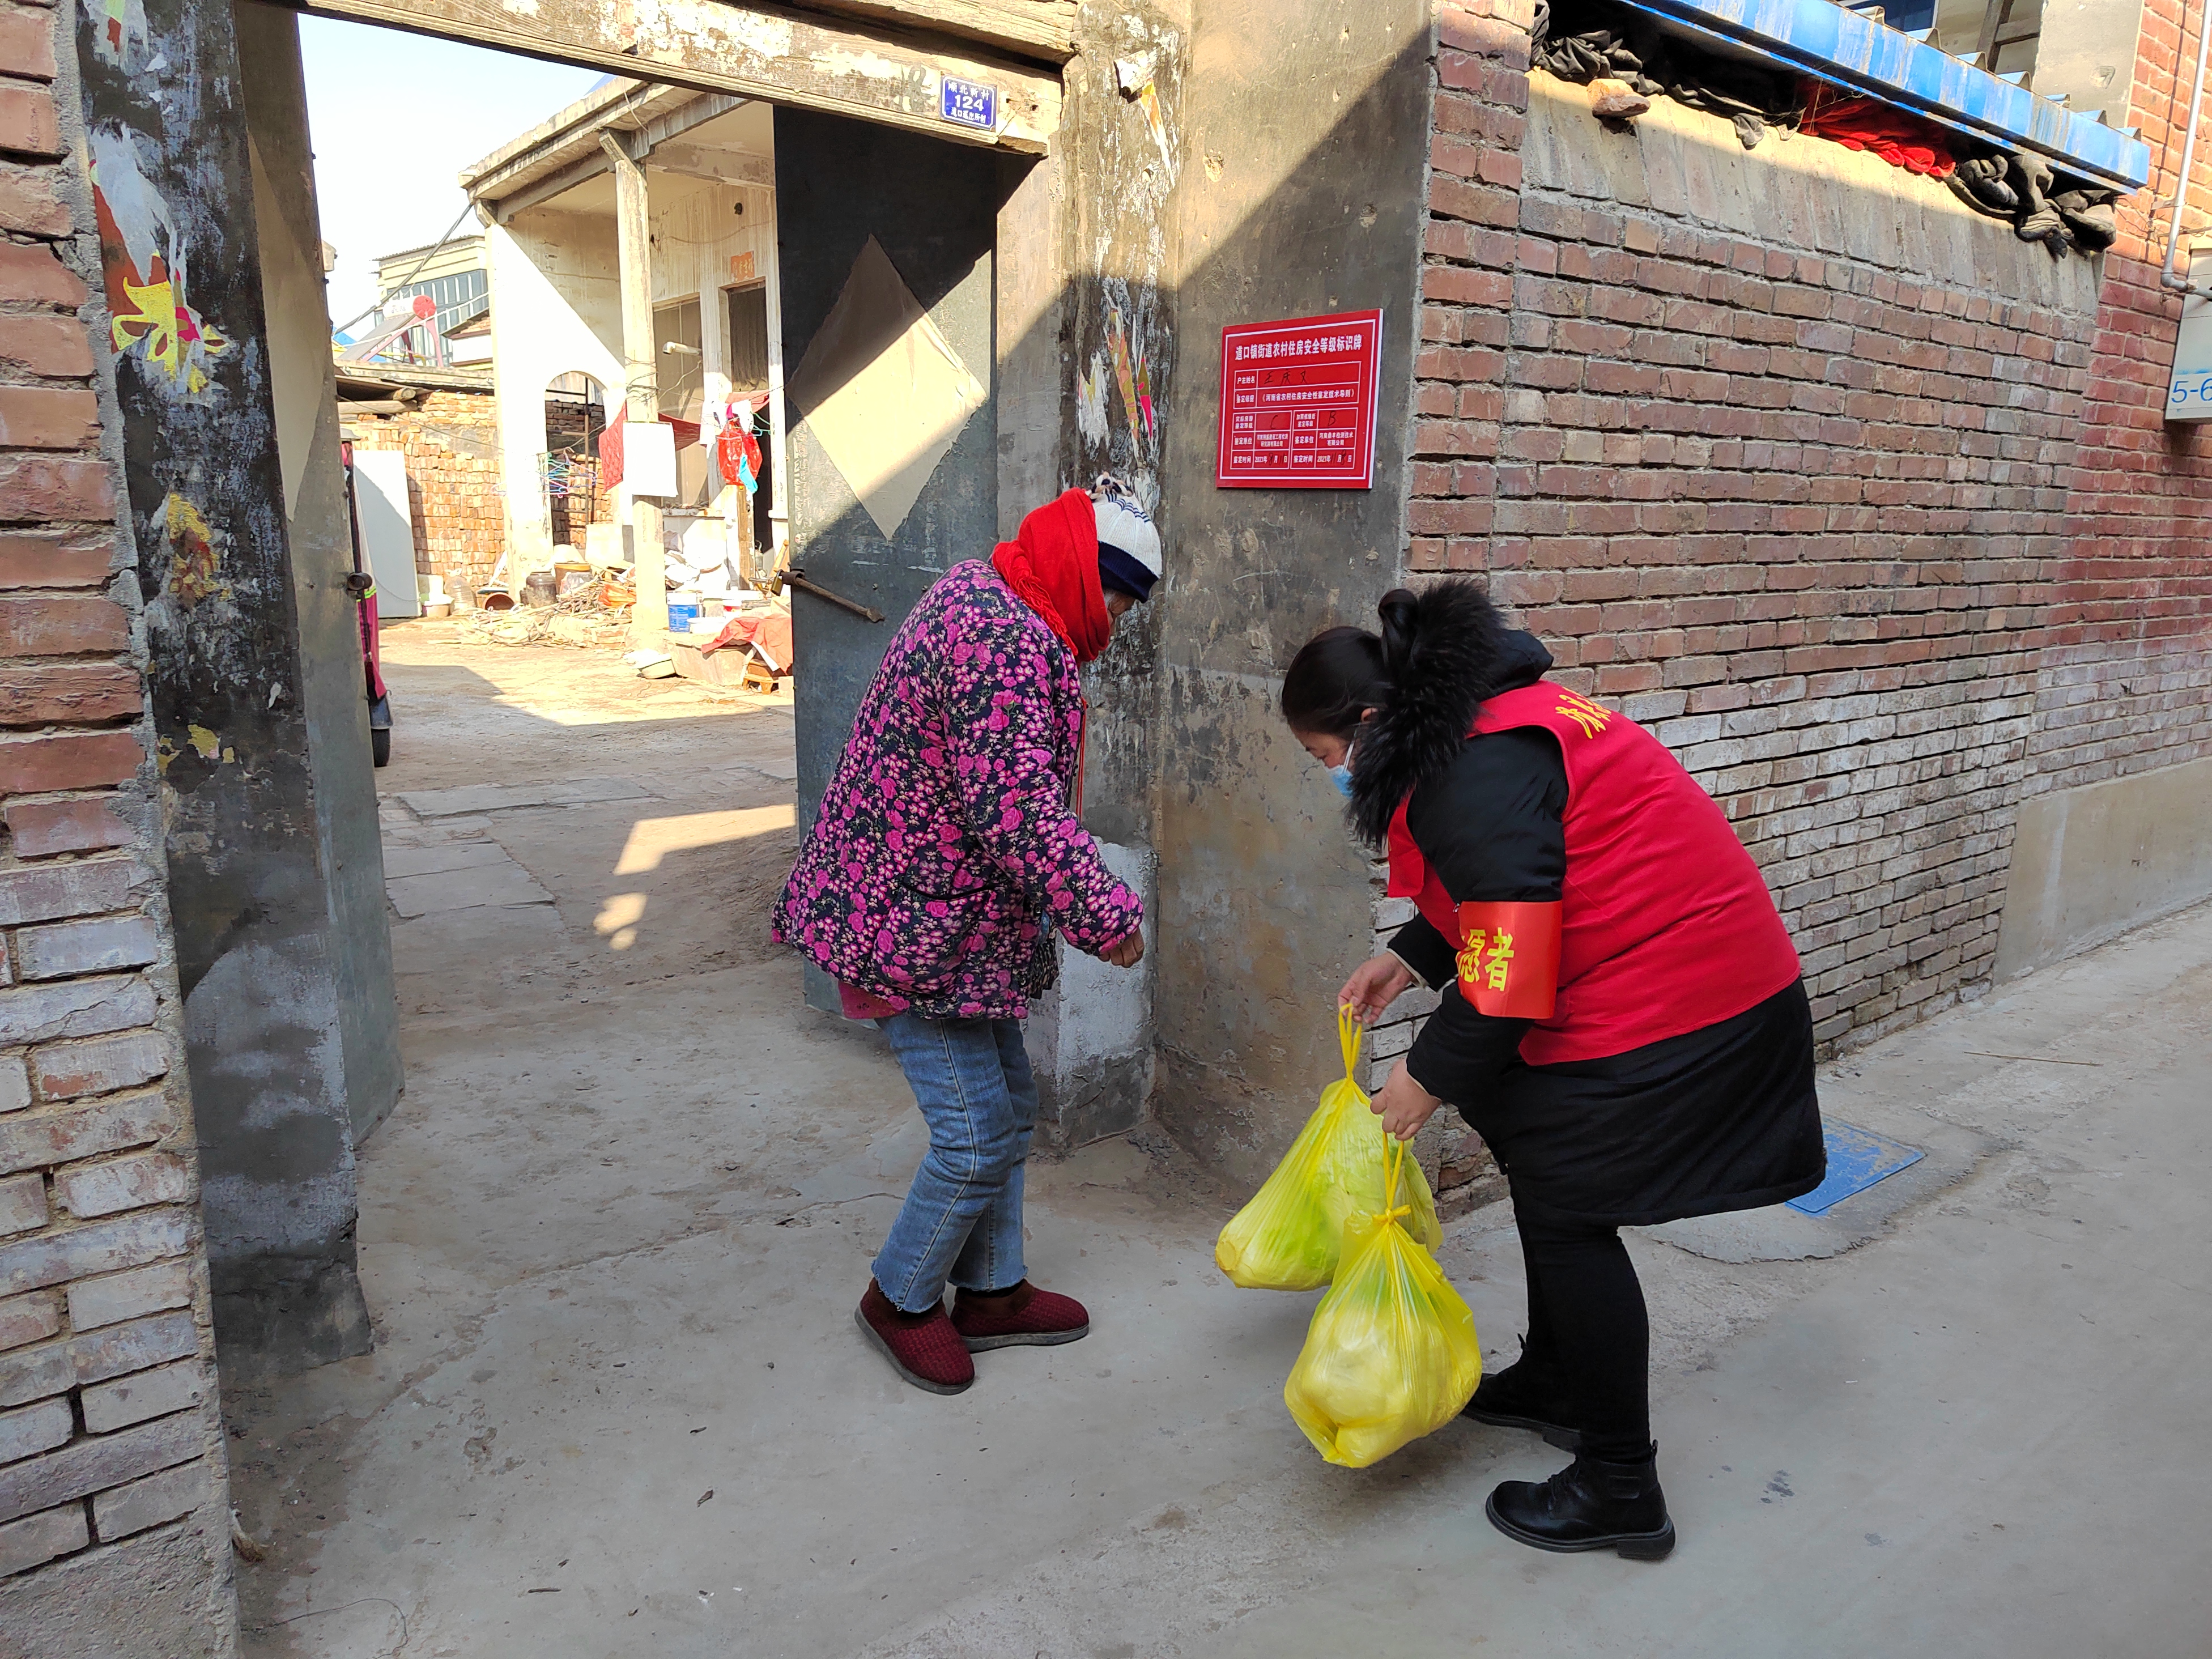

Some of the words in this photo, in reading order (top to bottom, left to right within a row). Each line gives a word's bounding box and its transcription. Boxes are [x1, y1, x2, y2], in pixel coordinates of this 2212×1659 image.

[954, 94, 984, 112] 124
[1235, 334, 1362, 360] 道口镇街道农村住房安全等级标识牌
[1328, 410, 1336, 427] B
